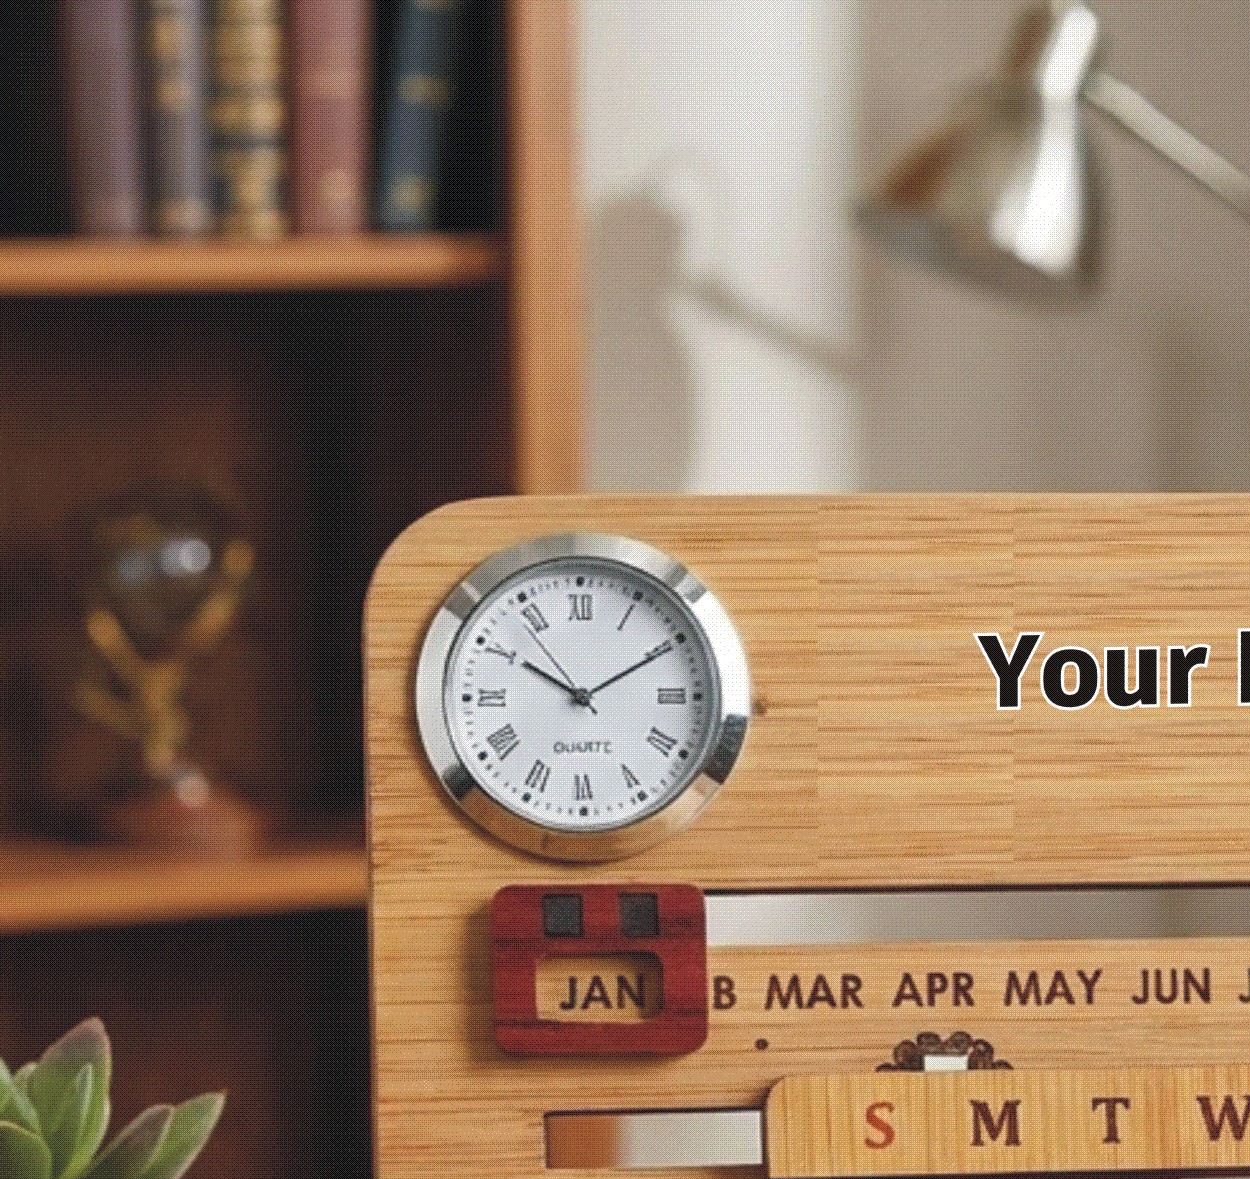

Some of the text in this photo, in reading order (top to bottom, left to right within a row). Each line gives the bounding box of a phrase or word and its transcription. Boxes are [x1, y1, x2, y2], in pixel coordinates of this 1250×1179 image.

[559, 975, 645, 1011] JAN
[764, 973, 864, 1010] MAR
[891, 972, 975, 1007] APR
[1003, 970, 1102, 1006] MAY
[1132, 968, 1212, 1006] JUN
[864, 1102, 896, 1149] S
[969, 1099, 1022, 1147] M
[1092, 1096, 1130, 1143] T
